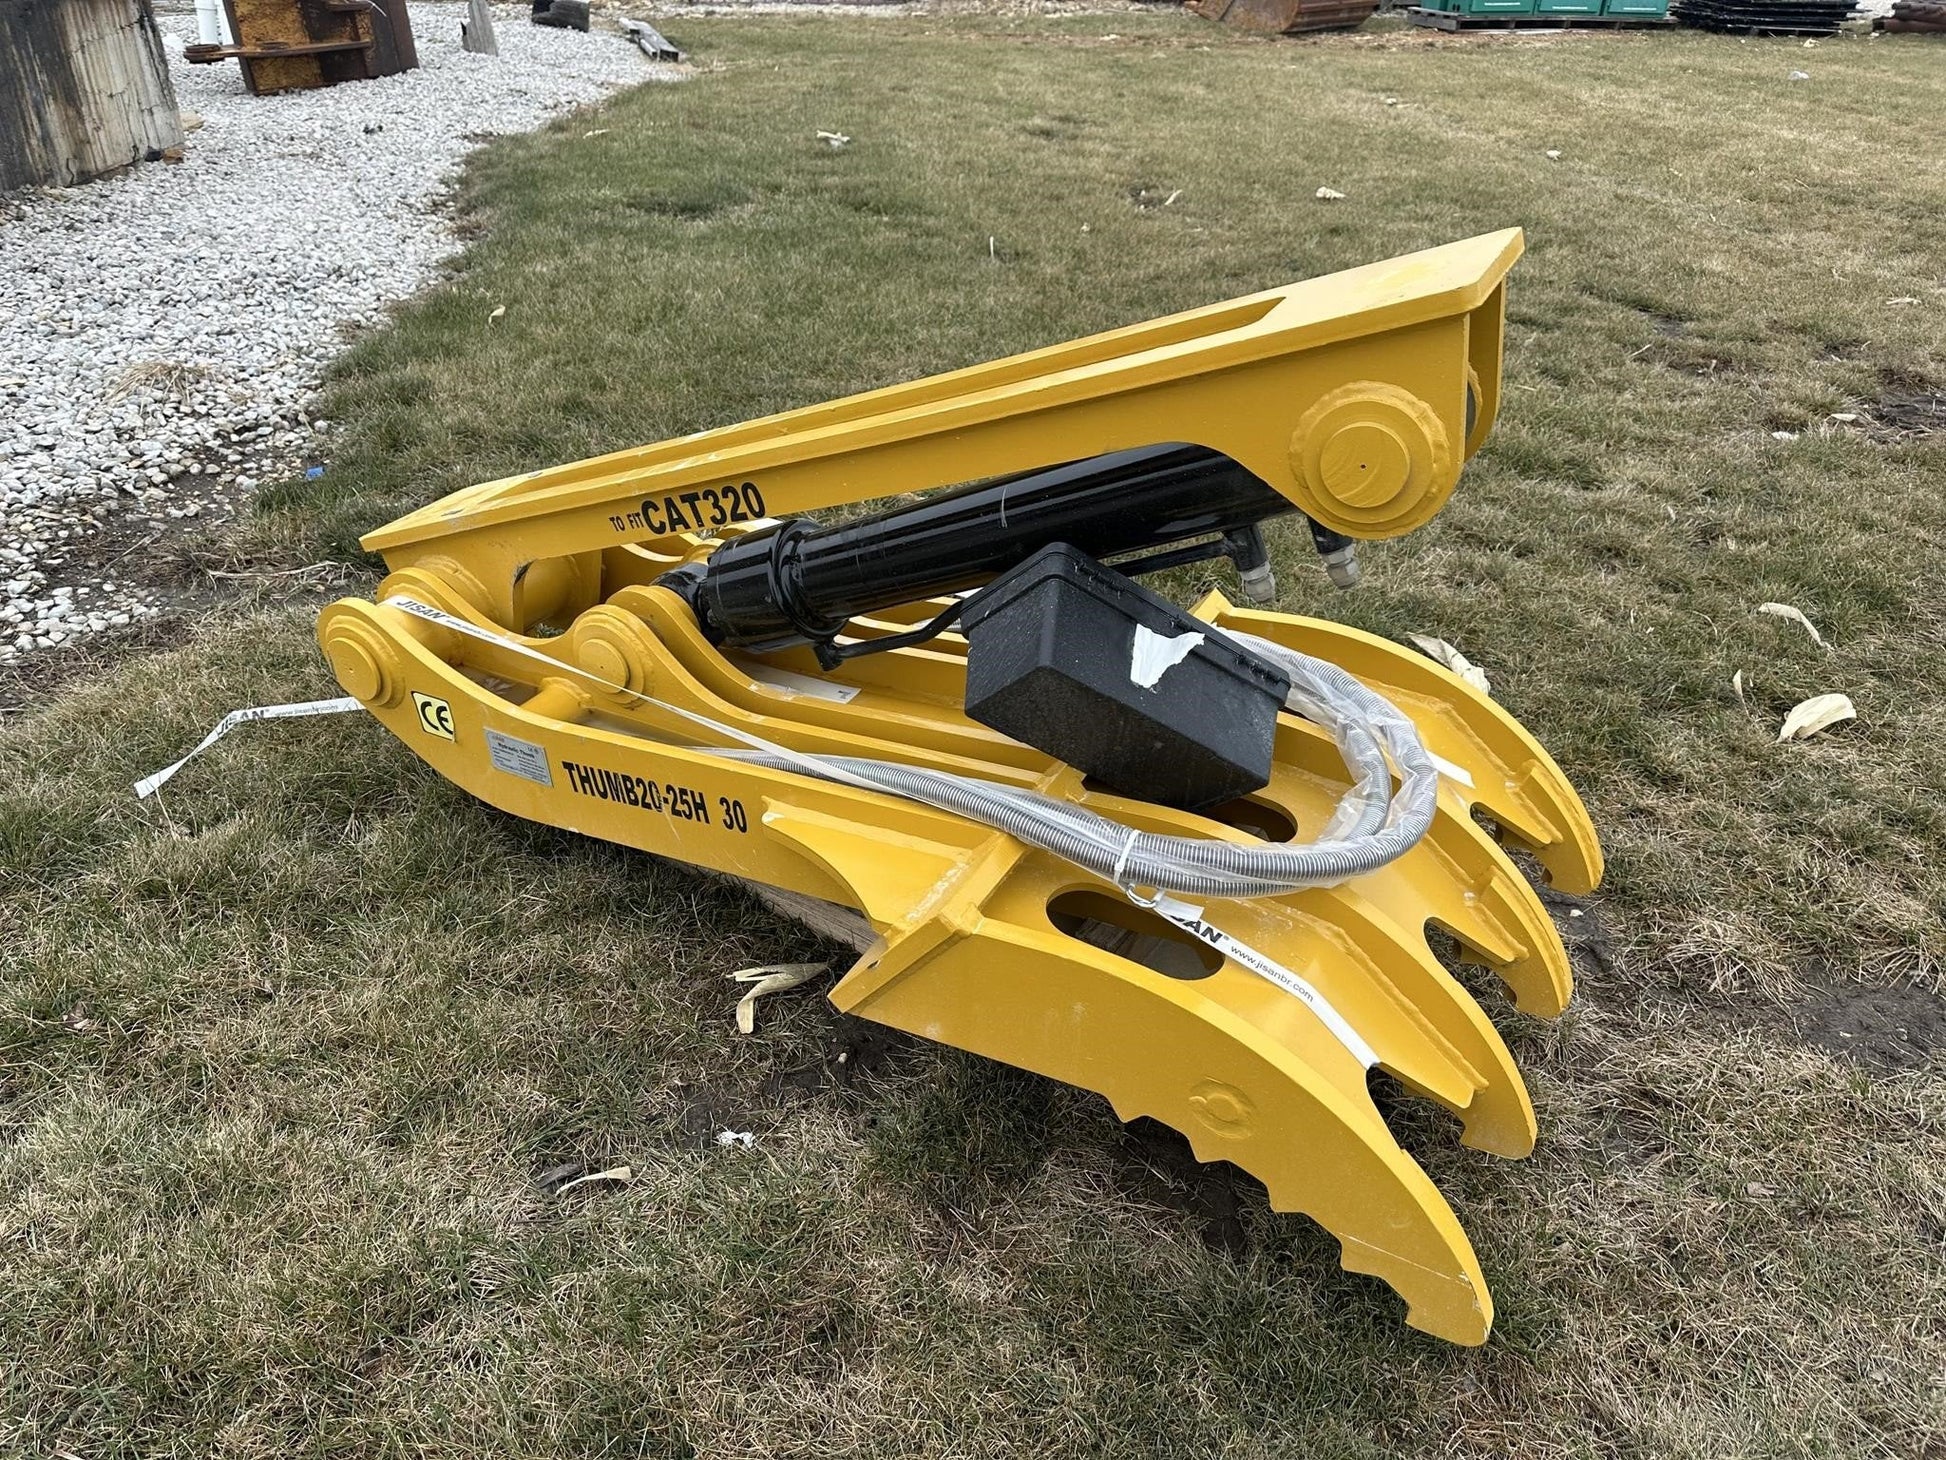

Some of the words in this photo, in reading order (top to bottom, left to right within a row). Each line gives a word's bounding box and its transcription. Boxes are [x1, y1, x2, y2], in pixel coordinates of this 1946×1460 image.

[609, 516, 625, 532] TO
[627, 512, 644, 529] FIT
[641, 481, 766, 535] CAT320
[420, 701, 453, 735] CE
[562, 761, 710, 824] THUMB20-25H
[719, 796, 747, 833] 30
[1231, 945, 1314, 1003] www.jisanbr.com
